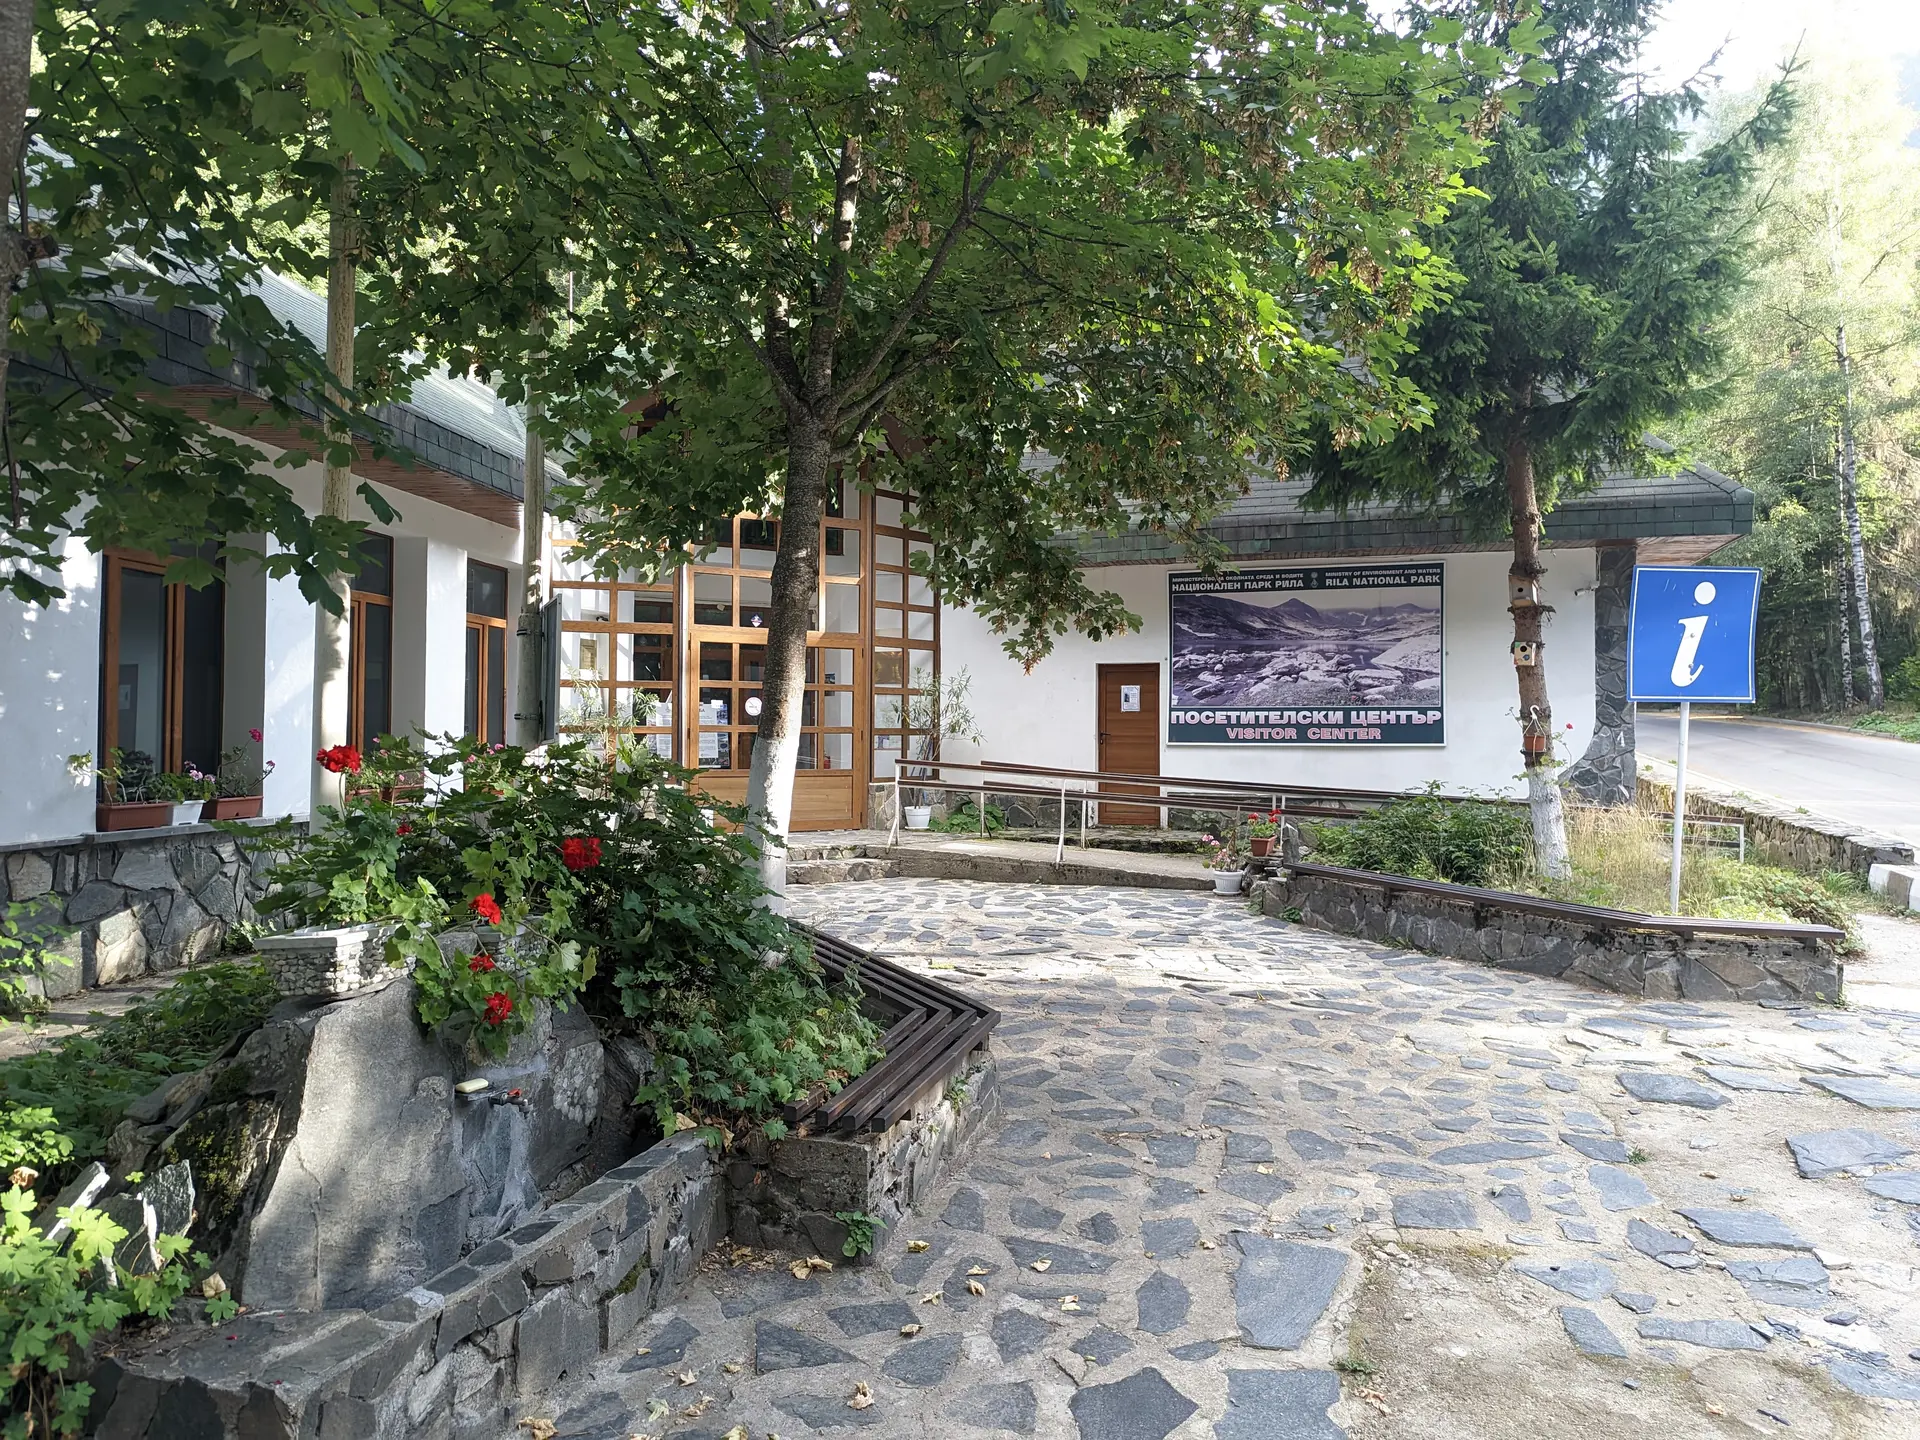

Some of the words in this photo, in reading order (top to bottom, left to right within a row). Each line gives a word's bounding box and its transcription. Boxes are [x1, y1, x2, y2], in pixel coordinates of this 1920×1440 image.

[1172, 582, 1240, 592] НАЦИОНАЛЕН
[1244, 581, 1272, 589] ПАРК
[1275, 579, 1304, 588] РИЛА
[1325, 578, 1349, 586] RILA
[1352, 576, 1407, 586] NATIONAL
[1410, 575, 1440, 583] PARK
[1670, 581, 1716, 688] i
[1170, 710, 1344, 725] ПОСЕТИТЕЛСКИ
[1350, 710, 1442, 726] ЦЕНТЪР
[1226, 727, 1297, 740] VISITOR
[1307, 727, 1381, 740] CENTER
